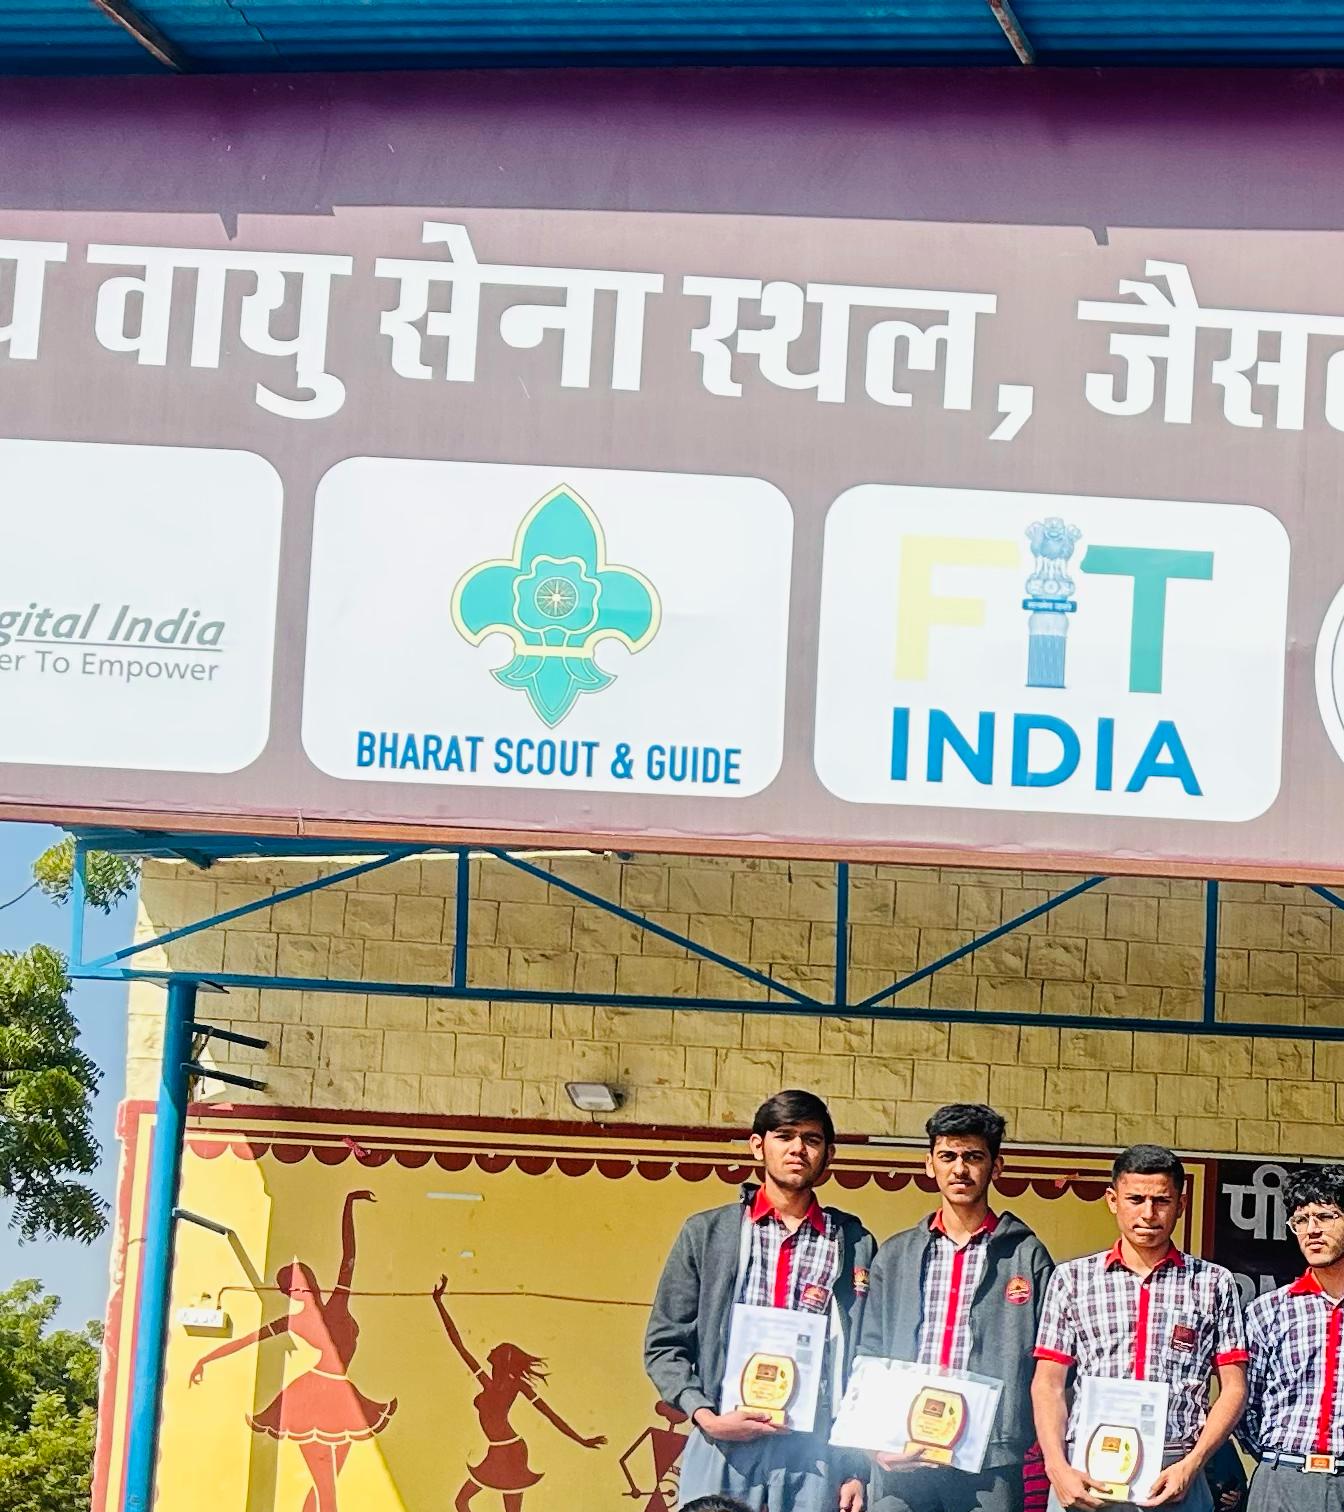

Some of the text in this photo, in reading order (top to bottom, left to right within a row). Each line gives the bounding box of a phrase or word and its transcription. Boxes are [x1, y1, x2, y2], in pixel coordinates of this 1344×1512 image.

[86, 243, 353, 421] वायु
[374, 220, 664, 392] सेना
[684, 275, 1034, 442] स्थल,
[108, 604, 225, 647] India
[35, 650, 70, 674] To
[82, 652, 219, 683] Empower
[356, 731, 742, 785] BHARAT SCOUT & GUIDE
[889, 707, 1205, 799] INDIA
